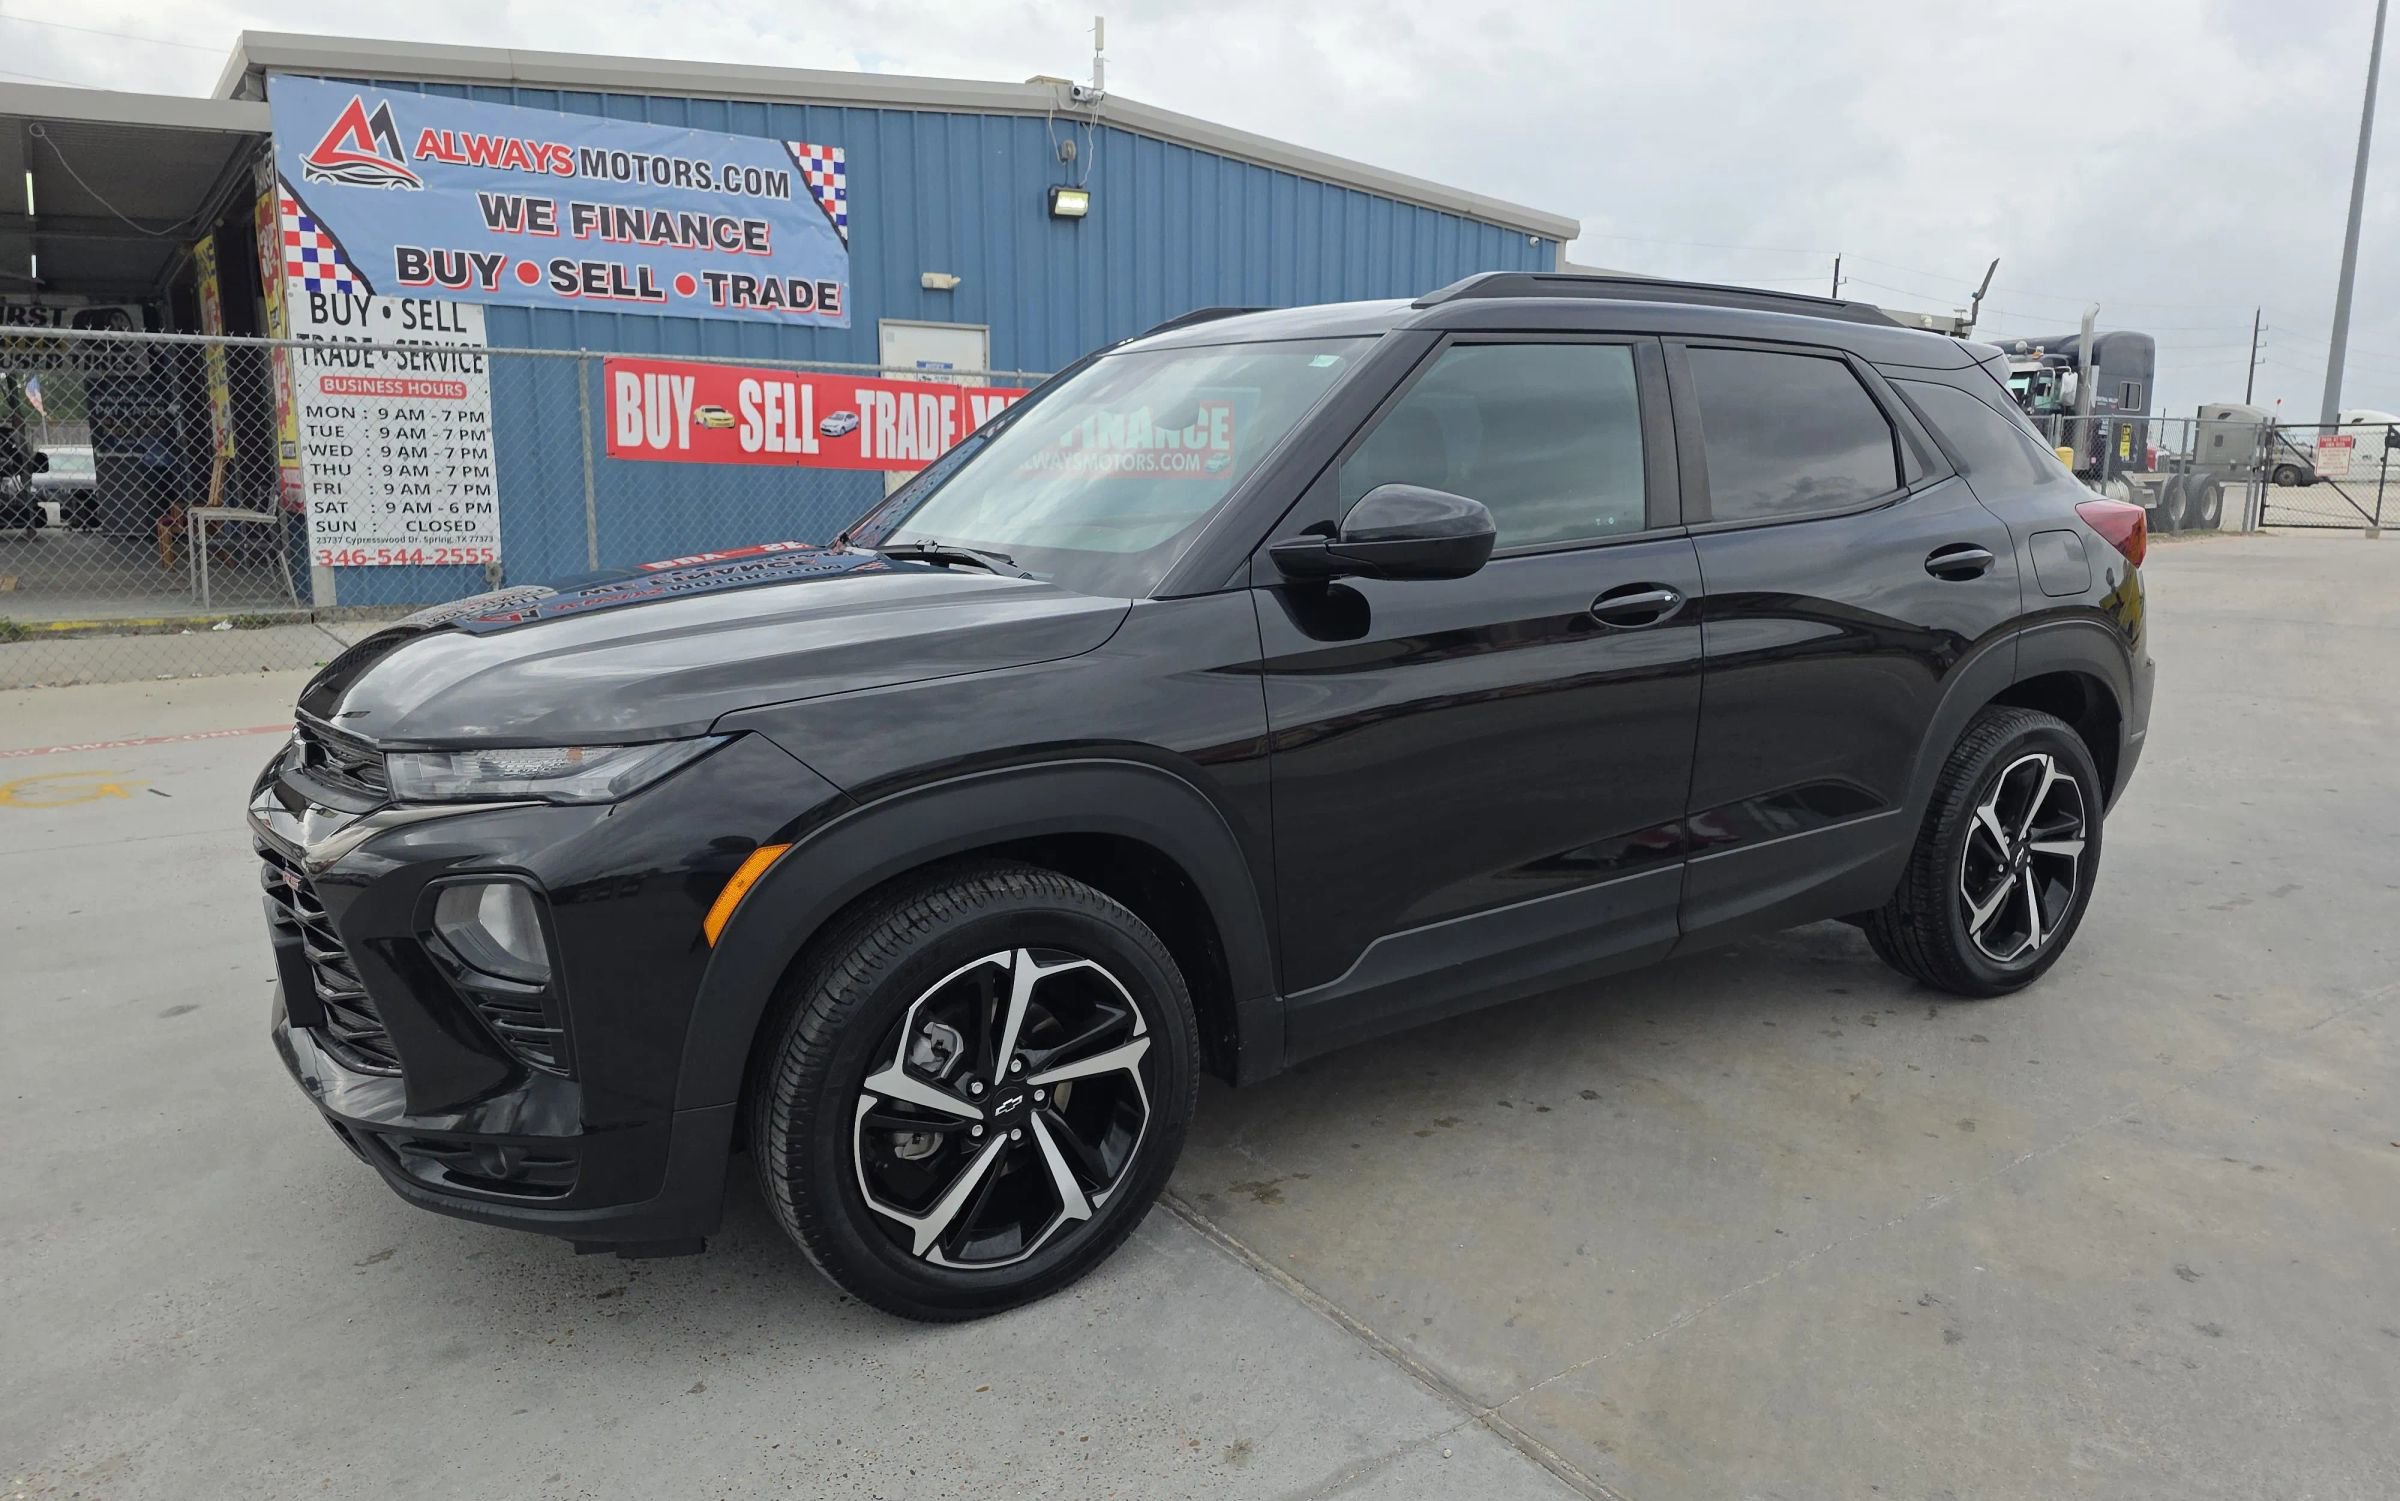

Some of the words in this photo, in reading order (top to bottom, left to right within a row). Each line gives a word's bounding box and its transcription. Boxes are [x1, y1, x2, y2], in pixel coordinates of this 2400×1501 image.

[476, 191, 560, 237] WE
[569, 200, 772, 256] FINANCE
[394, 245, 507, 291] BUY
[548, 257, 668, 303] SELL
[700, 269, 842, 315] TRADE
[310, 292, 371, 327] BUY
[401, 299, 467, 333] SELL
[296, 333, 375, 368] TRADE
[396, 339, 483, 374] SERVICE
[324, 378, 404, 394] BUSINESS
[408, 381, 463, 396] HOURS
[306, 405, 356, 419] MON
[378, 408, 389, 420] 9
[395, 408, 425, 422] AM
[441, 410, 451, 422] 7
[458, 411, 485, 423] PM
[615, 371, 696, 450] BUY
[738, 378, 819, 454] SELL
[854, 388, 956, 461] TRADE
[308, 425, 344, 438] TUE
[379, 427, 390, 439] 9
[396, 428, 426, 440] AM
[443, 429, 453, 440] 7
[459, 430, 486, 441] PM
[309, 444, 353, 457] WED
[381, 446, 391, 458] 9
[398, 446, 427, 459] AM
[444, 447, 454, 459] 7
[461, 447, 488, 459] PM
[310, 463, 351, 476] THU
[382, 465, 393, 476] 9
[399, 465, 429, 477] AM
[446, 465, 456, 477] 7
[462, 466, 489, 477] PM
[313, 482, 342, 495] FRI
[384, 483, 394, 495] 9
[400, 484, 430, 495] AM
[447, 484, 457, 496] 7
[464, 484, 491, 496] PM
[314, 501, 348, 513] SAT
[385, 502, 396, 514] 9
[402, 502, 432, 514] AM
[449, 502, 460, 514] 6
[465, 502, 492, 514] PM
[316, 520, 357, 533] SUN
[406, 520, 476, 533] CLOSED
[316, 536, 342, 544] 23737
[346, 536, 406, 546] Cypresswood
[318, 548, 494, 566] 346-544-2555
